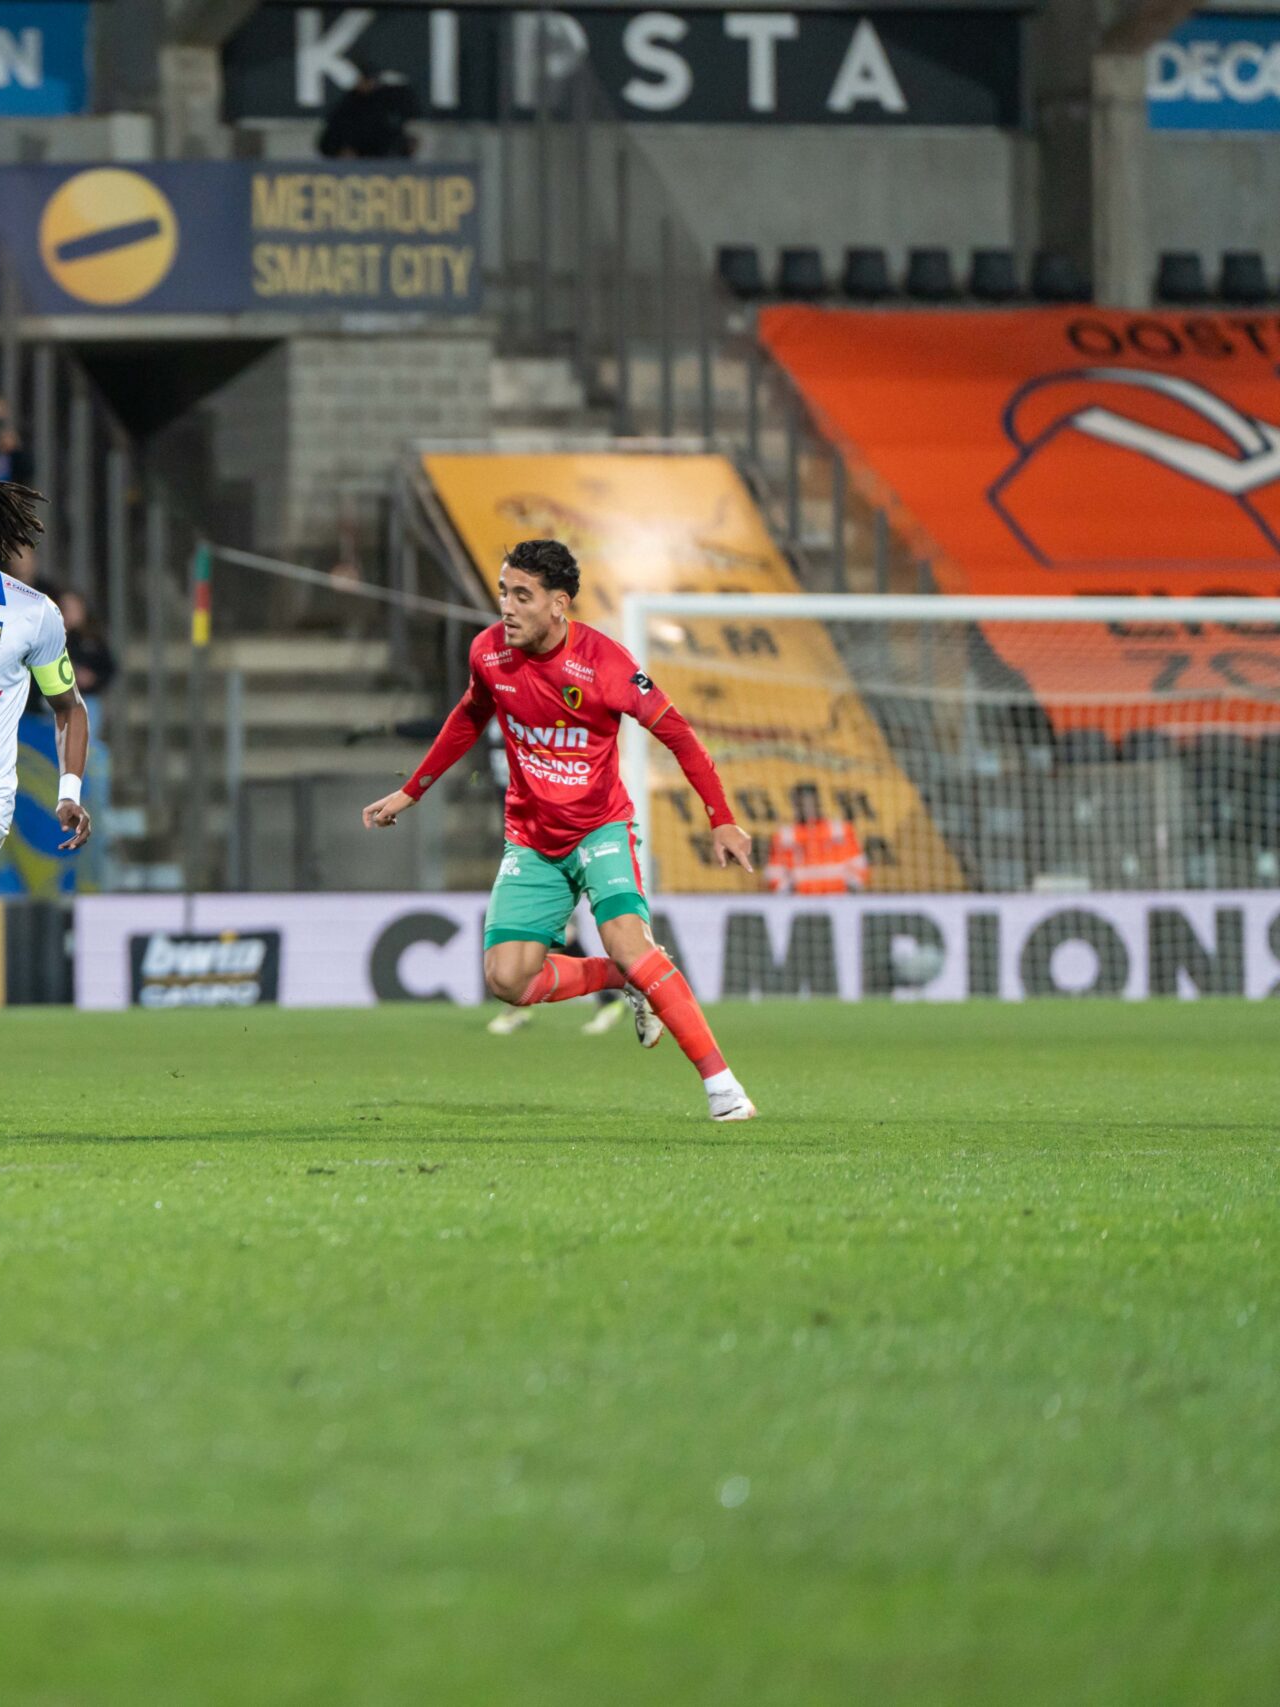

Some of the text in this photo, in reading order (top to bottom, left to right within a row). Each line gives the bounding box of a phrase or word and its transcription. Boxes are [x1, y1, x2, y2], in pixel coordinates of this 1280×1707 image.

[294, 8, 909, 112] KIPSTA
[1145, 40, 1280, 102] DEC
[252, 173, 475, 234] MERGROUP
[252, 243, 473, 298] SMART CITY
[1067, 318, 1280, 360] OOST
[482, 649, 512, 662] CALLANT
[495, 683, 517, 693] KIPSTA
[368, 910, 1280, 1001] CMPION
